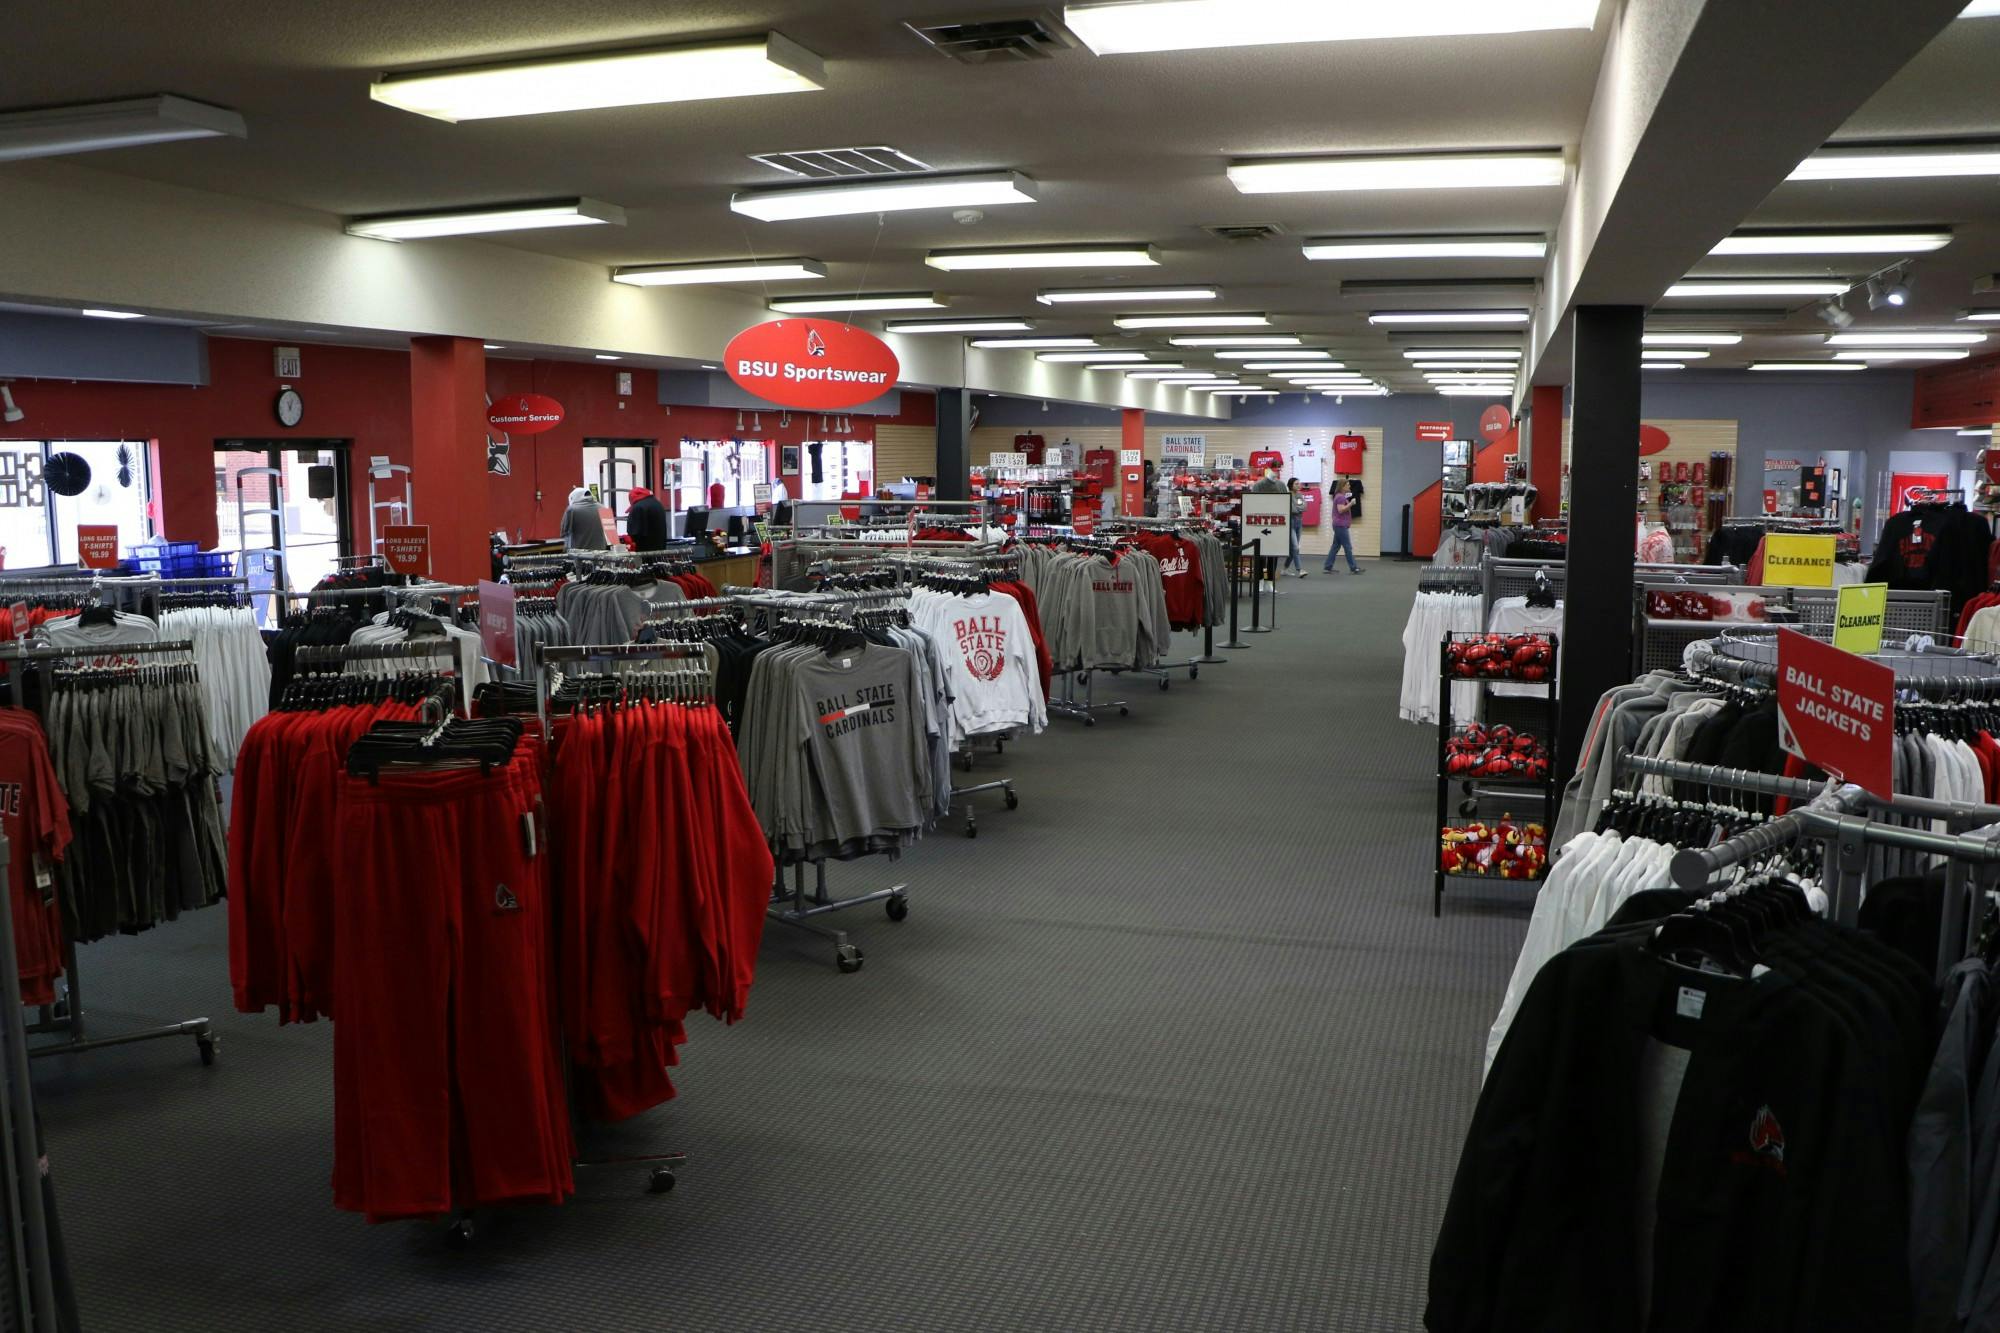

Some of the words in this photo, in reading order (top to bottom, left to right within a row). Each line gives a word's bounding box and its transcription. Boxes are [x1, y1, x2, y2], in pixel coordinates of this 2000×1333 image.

[738, 360, 777, 377] BSU
[783, 363, 887, 383] Sportswear
[490, 415, 527, 423] Customer
[529, 413, 560, 422] Service
[1165, 445, 1202, 454] CARDINALS
[1166, 437, 1181, 445] BALL
[1183, 437, 1201, 445] STATE
[1246, 514, 1286, 526] ENTER
[1768, 554, 1831, 567] CLEARANCE
[1092, 581, 1111, 592] BALL
[953, 615, 1006, 641] BALL
[1839, 614, 1881, 628] CLEARANCE
[960, 634, 1004, 655] STATE
[816, 694, 849, 716] BALL
[856, 683, 895, 704] STATE
[1786, 665, 1826, 697] BALL
[1831, 684, 1884, 721] STATE
[825, 707, 895, 739] CARDINALS
[1795, 696, 1872, 742] JACKETS
